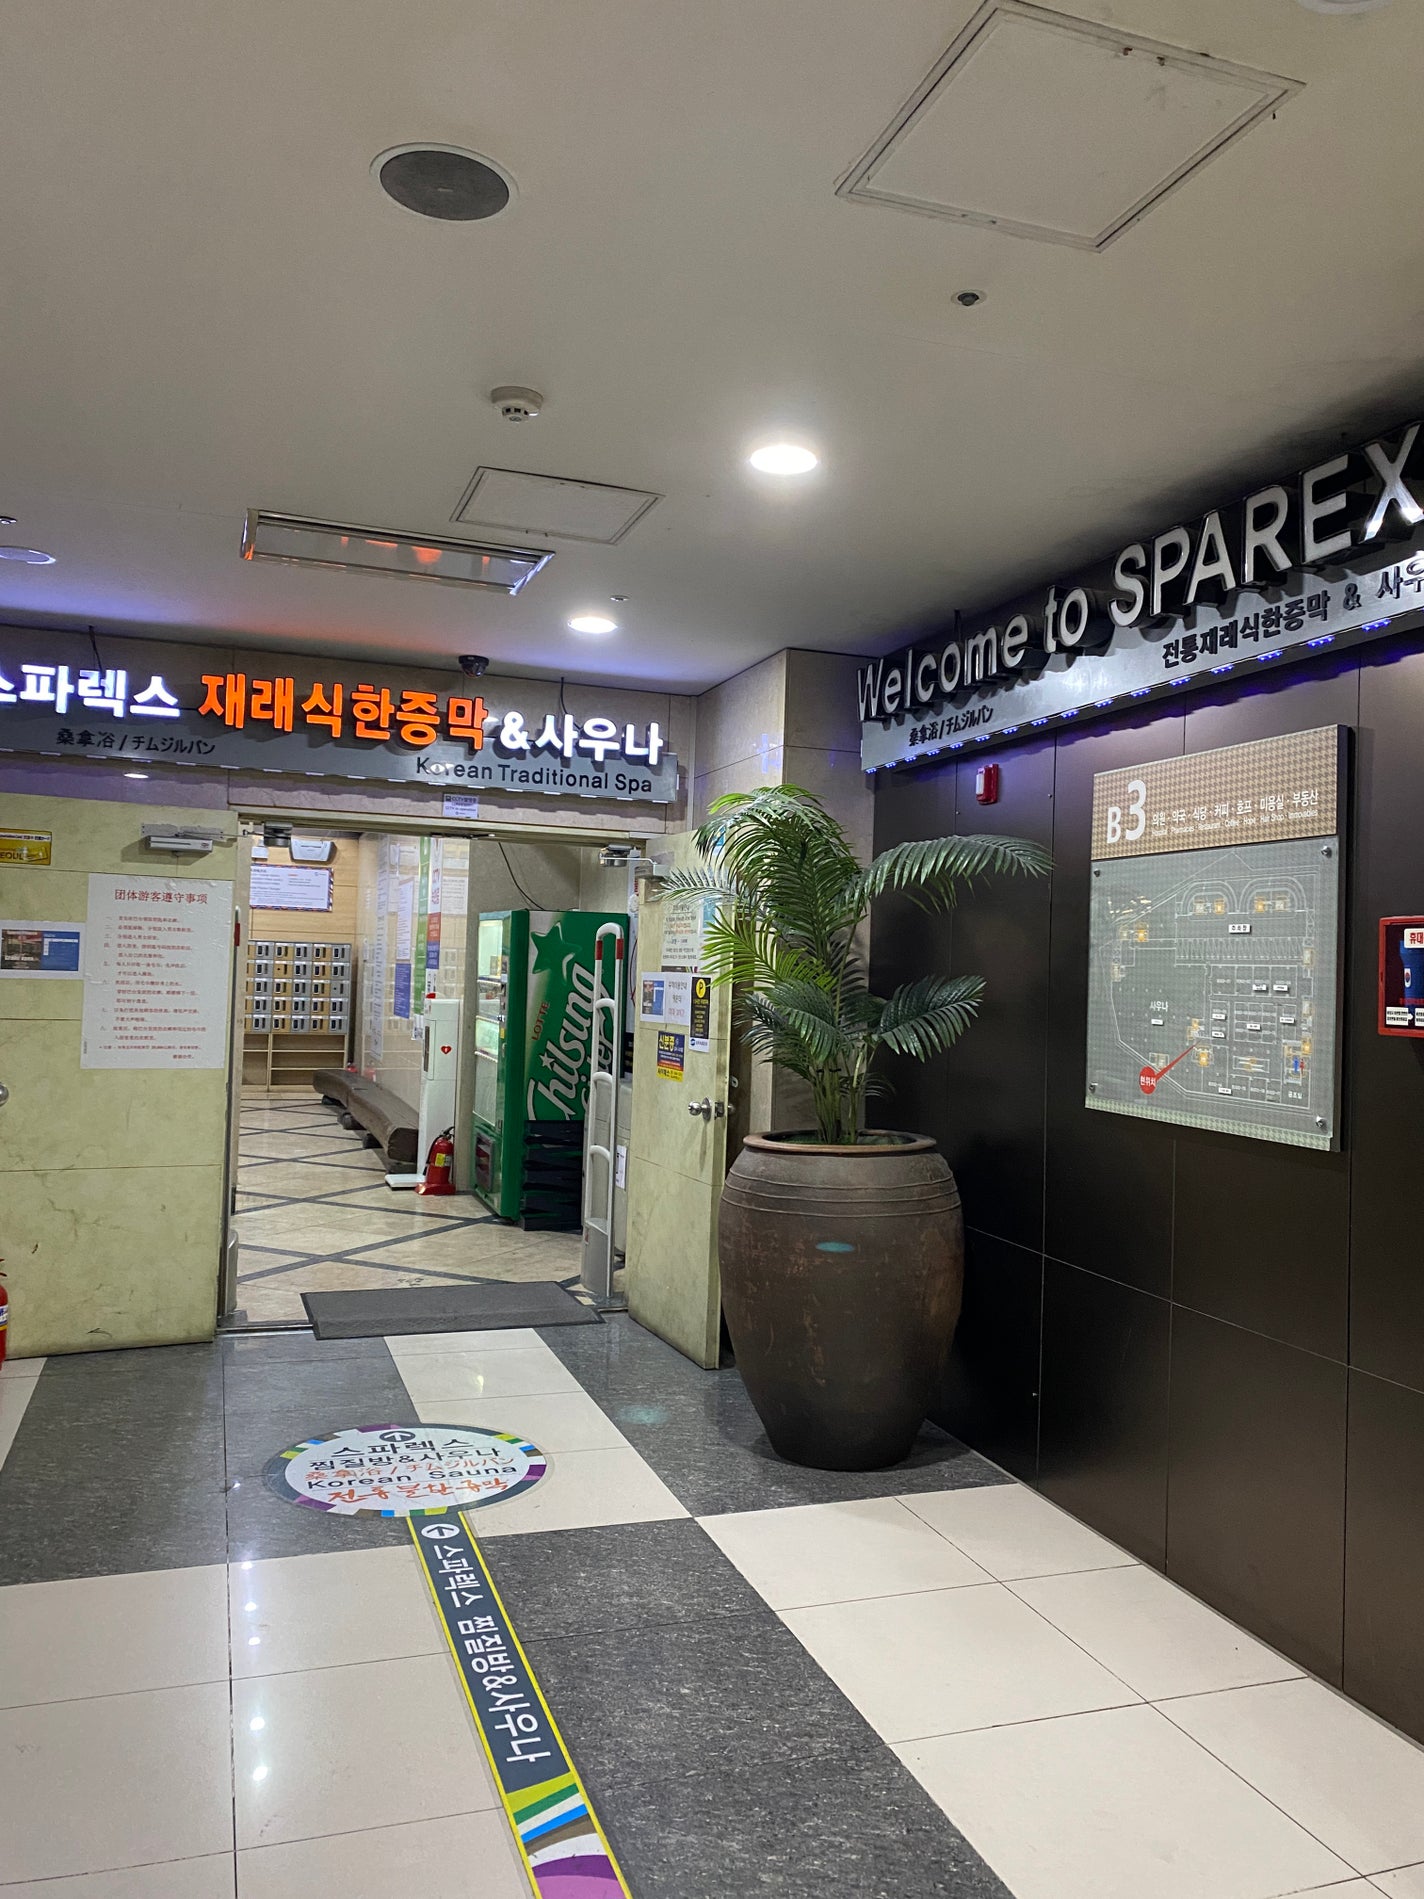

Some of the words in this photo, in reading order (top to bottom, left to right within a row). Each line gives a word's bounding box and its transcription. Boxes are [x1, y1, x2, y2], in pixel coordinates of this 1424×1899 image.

[857, 612, 1028, 721] Welcome
[1044, 583, 1090, 653] to
[1108, 424, 1424, 627] SPAREX
[1162, 589, 1331, 669] 전통재래식한증막
[1343, 582, 1363, 611] &
[198, 672, 489, 751] 재래식한증막
[416, 756, 493, 781] Korean
[498, 764, 609, 791] Traditional
[614, 774, 653, 795] Spa
[1259, 794, 1285, 812] 미용실
[1292, 789, 1319, 808] 부동산
[114, 889, 208, 904] 团体游客遵守事项
[531, 1001, 549, 1041] LOTTE
[309, 1447, 501, 1471] 찜질방&사우나
[331, 1438, 475, 1458] 스파렉스
[307, 1474, 412, 1490] Korean
[429, 1465, 517, 1480] Sauna
[434, 1545, 484, 1608] 스파렉스
[457, 1614, 552, 1763] 찜질방&사우나
